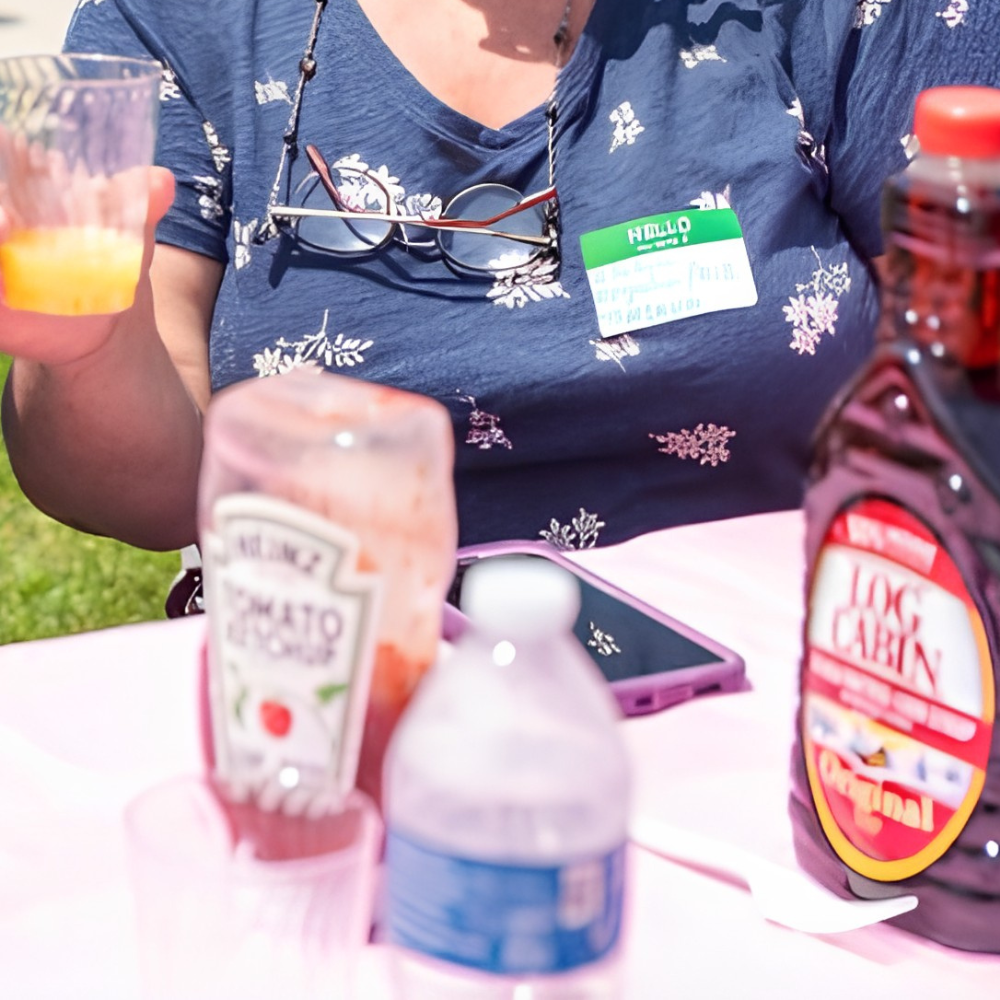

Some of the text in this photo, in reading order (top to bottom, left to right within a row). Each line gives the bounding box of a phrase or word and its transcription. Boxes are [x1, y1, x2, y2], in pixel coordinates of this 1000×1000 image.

[628, 216, 692, 245] HELLO
[848, 562, 921, 637] LOG
[832, 604, 943, 698] CABIN
[818, 749, 935, 837] Original
